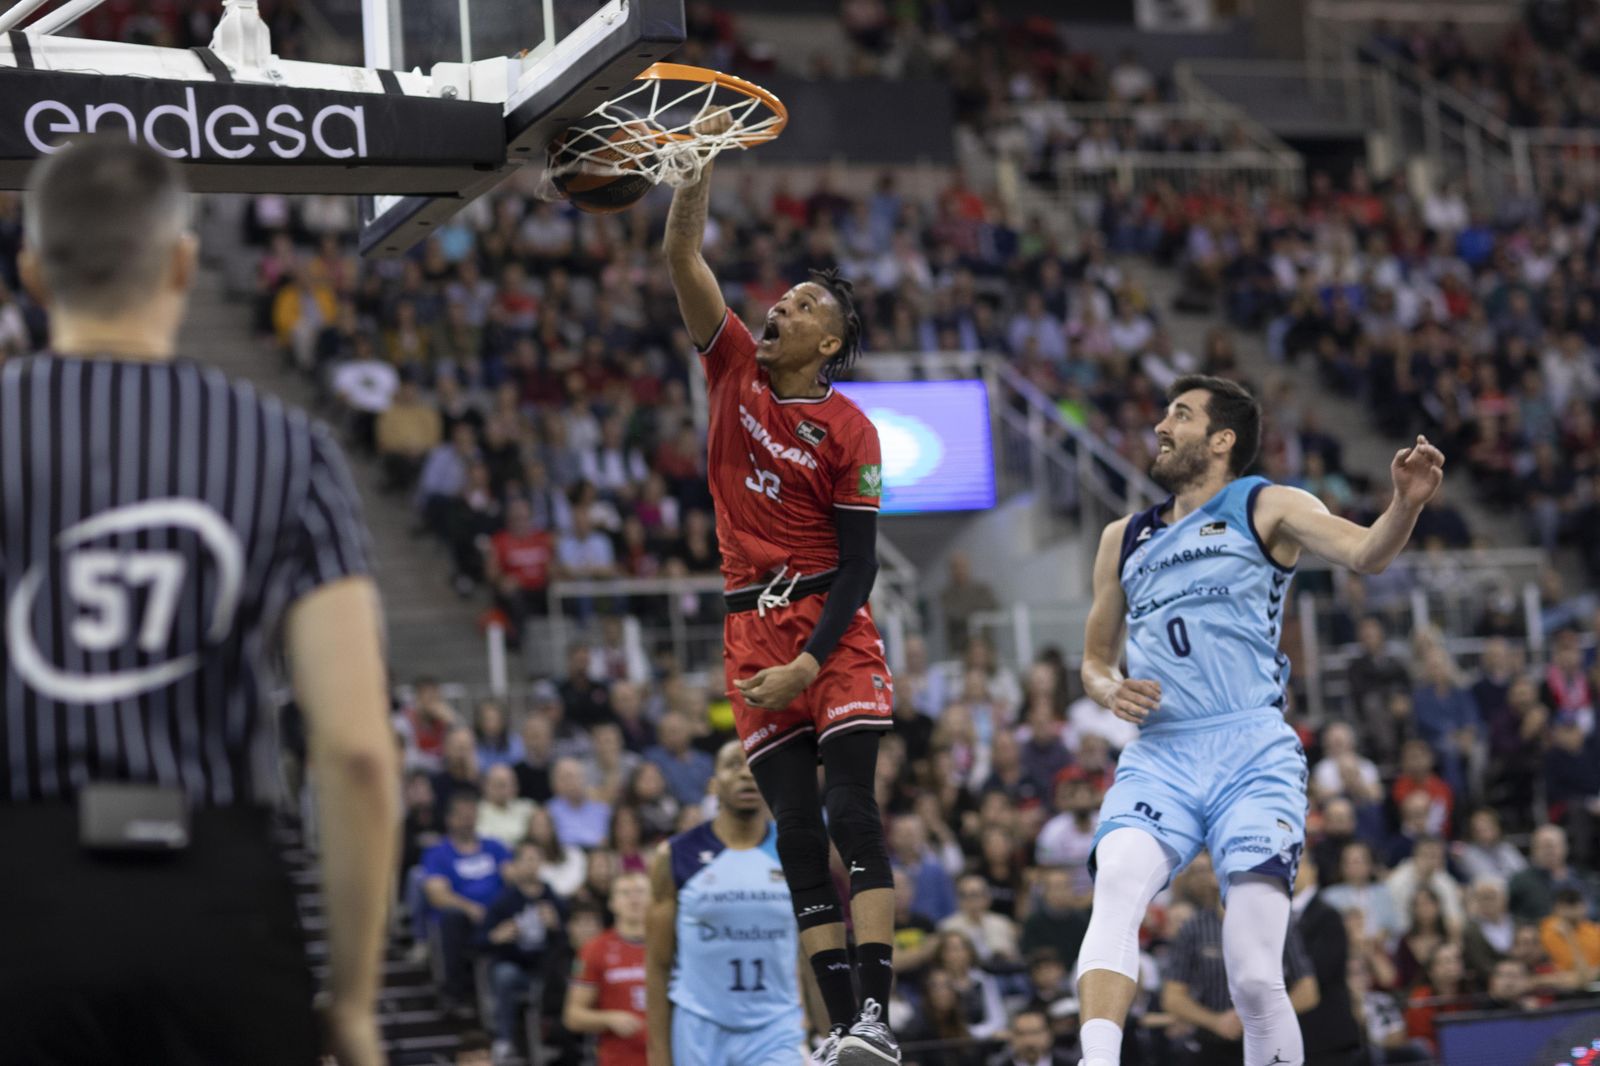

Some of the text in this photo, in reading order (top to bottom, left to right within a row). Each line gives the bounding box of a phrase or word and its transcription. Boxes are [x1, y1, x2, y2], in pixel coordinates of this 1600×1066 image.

[24, 87, 368, 160] endesa
[68, 551, 187, 652] 57
[1167, 616, 1191, 657] 0
[729, 958, 767, 992] 11
